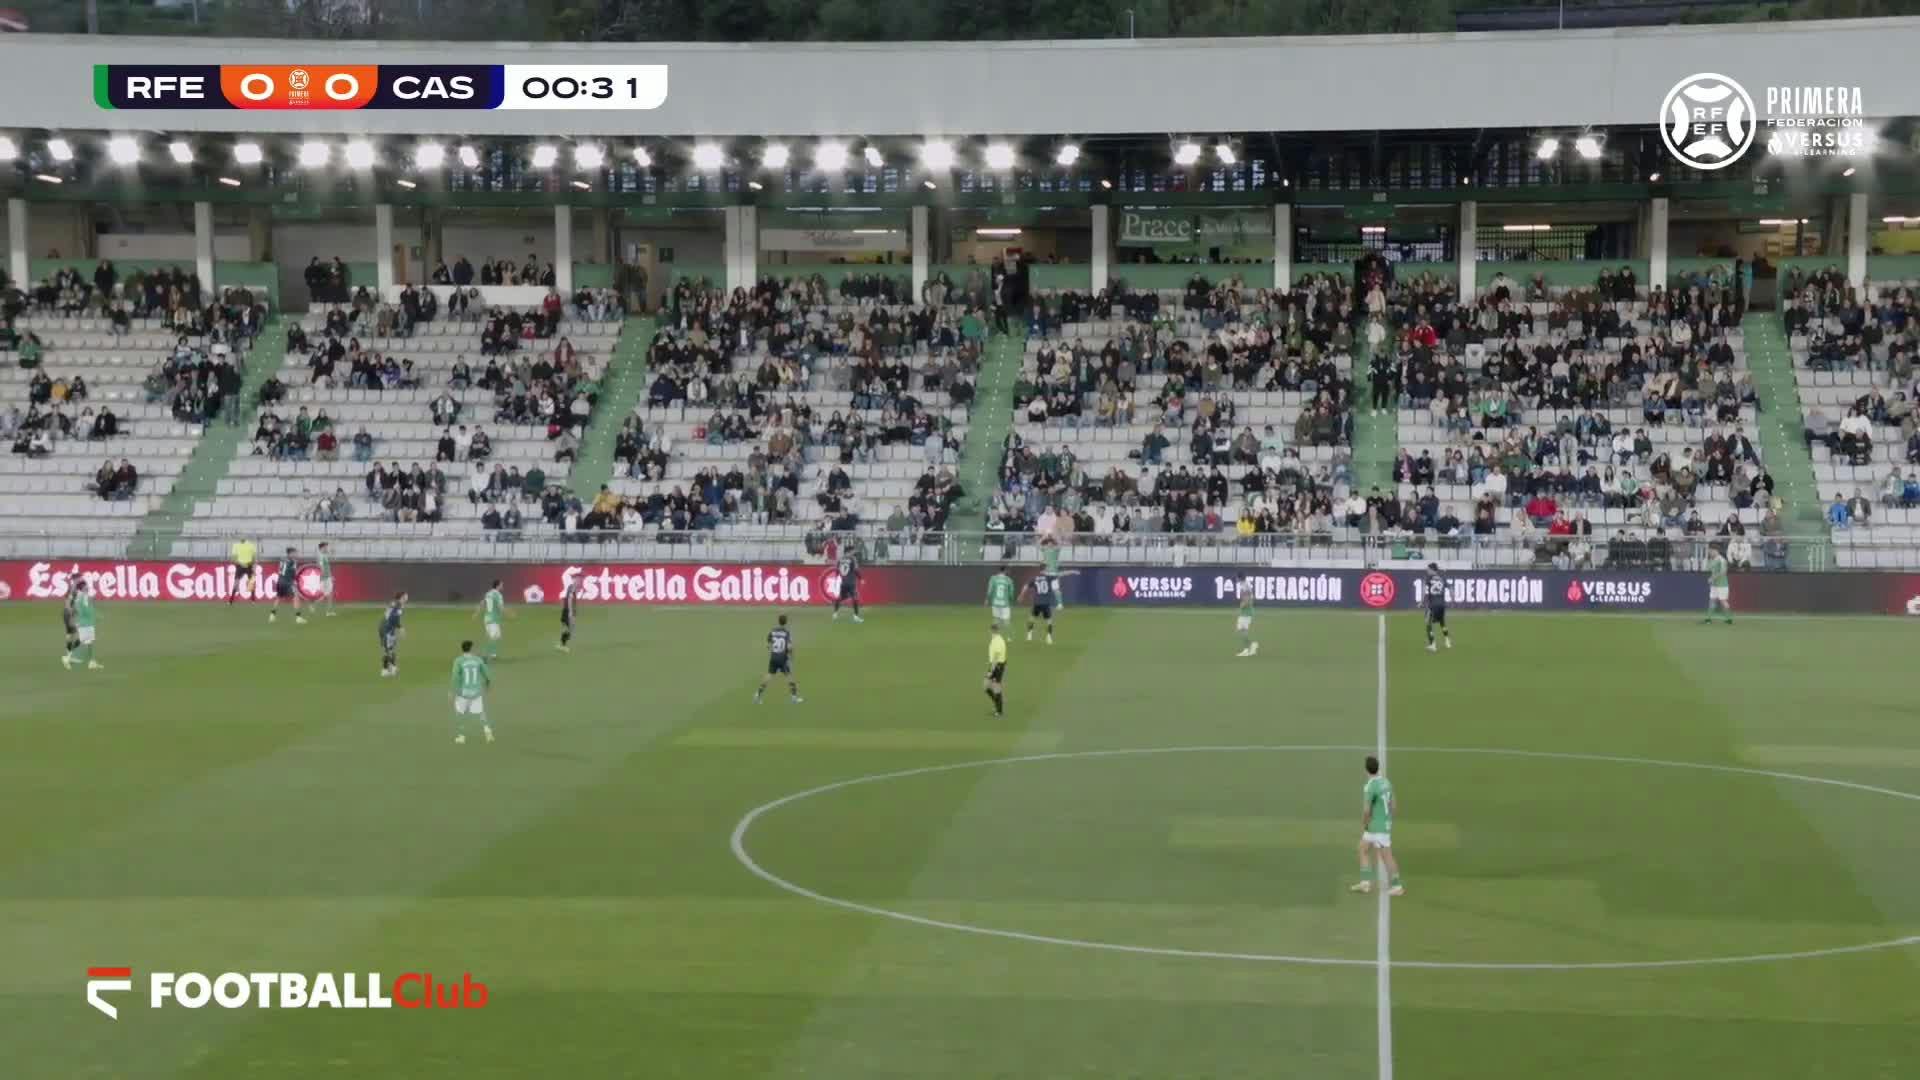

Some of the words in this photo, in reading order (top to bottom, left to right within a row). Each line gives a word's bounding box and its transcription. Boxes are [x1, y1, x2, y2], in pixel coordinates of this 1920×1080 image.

[560, 566, 686, 600] Estrella
[692, 566, 810, 601] Galicia
[1035, 580, 1048, 594] 10
[1128, 577, 1192, 590] VERSUS
[1445, 576, 1543, 603] EDERACIÓN
[1583, 582, 1651, 595] VERSUS
[773, 637, 785, 652] 20
[464, 667, 477, 684] 11
